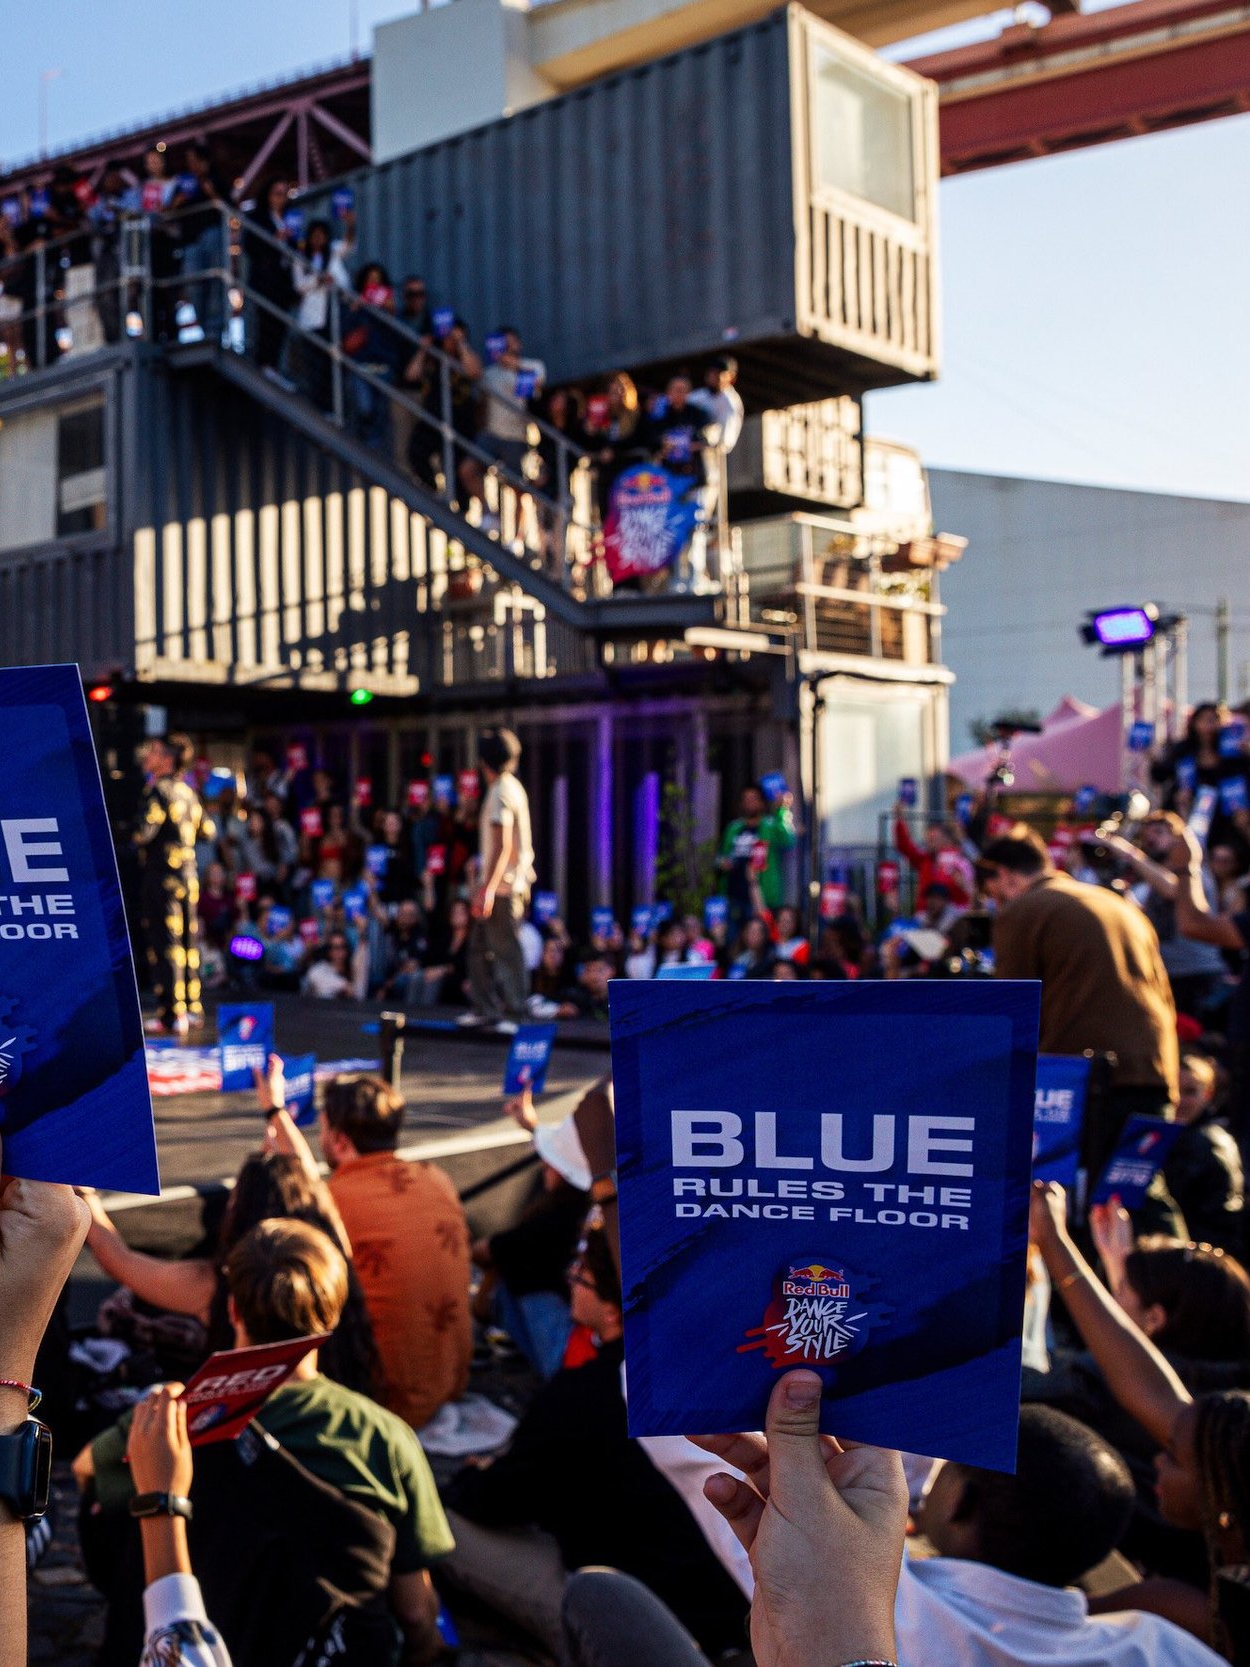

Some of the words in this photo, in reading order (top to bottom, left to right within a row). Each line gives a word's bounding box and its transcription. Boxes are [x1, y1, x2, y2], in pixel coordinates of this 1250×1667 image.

[670, 1110, 975, 1177] BLUE
[673, 1178, 845, 1200] RULES
[864, 1183, 972, 1208] THE
[675, 1203, 815, 1220] DANCE
[829, 1208, 970, 1230] FLOOR
[782, 1280, 816, 1296] Red
[817, 1283, 850, 1298] Bull
[783, 1297, 848, 1321] DANCE
[789, 1313, 854, 1337] YOUR
[784, 1330, 850, 1359] STYLE
